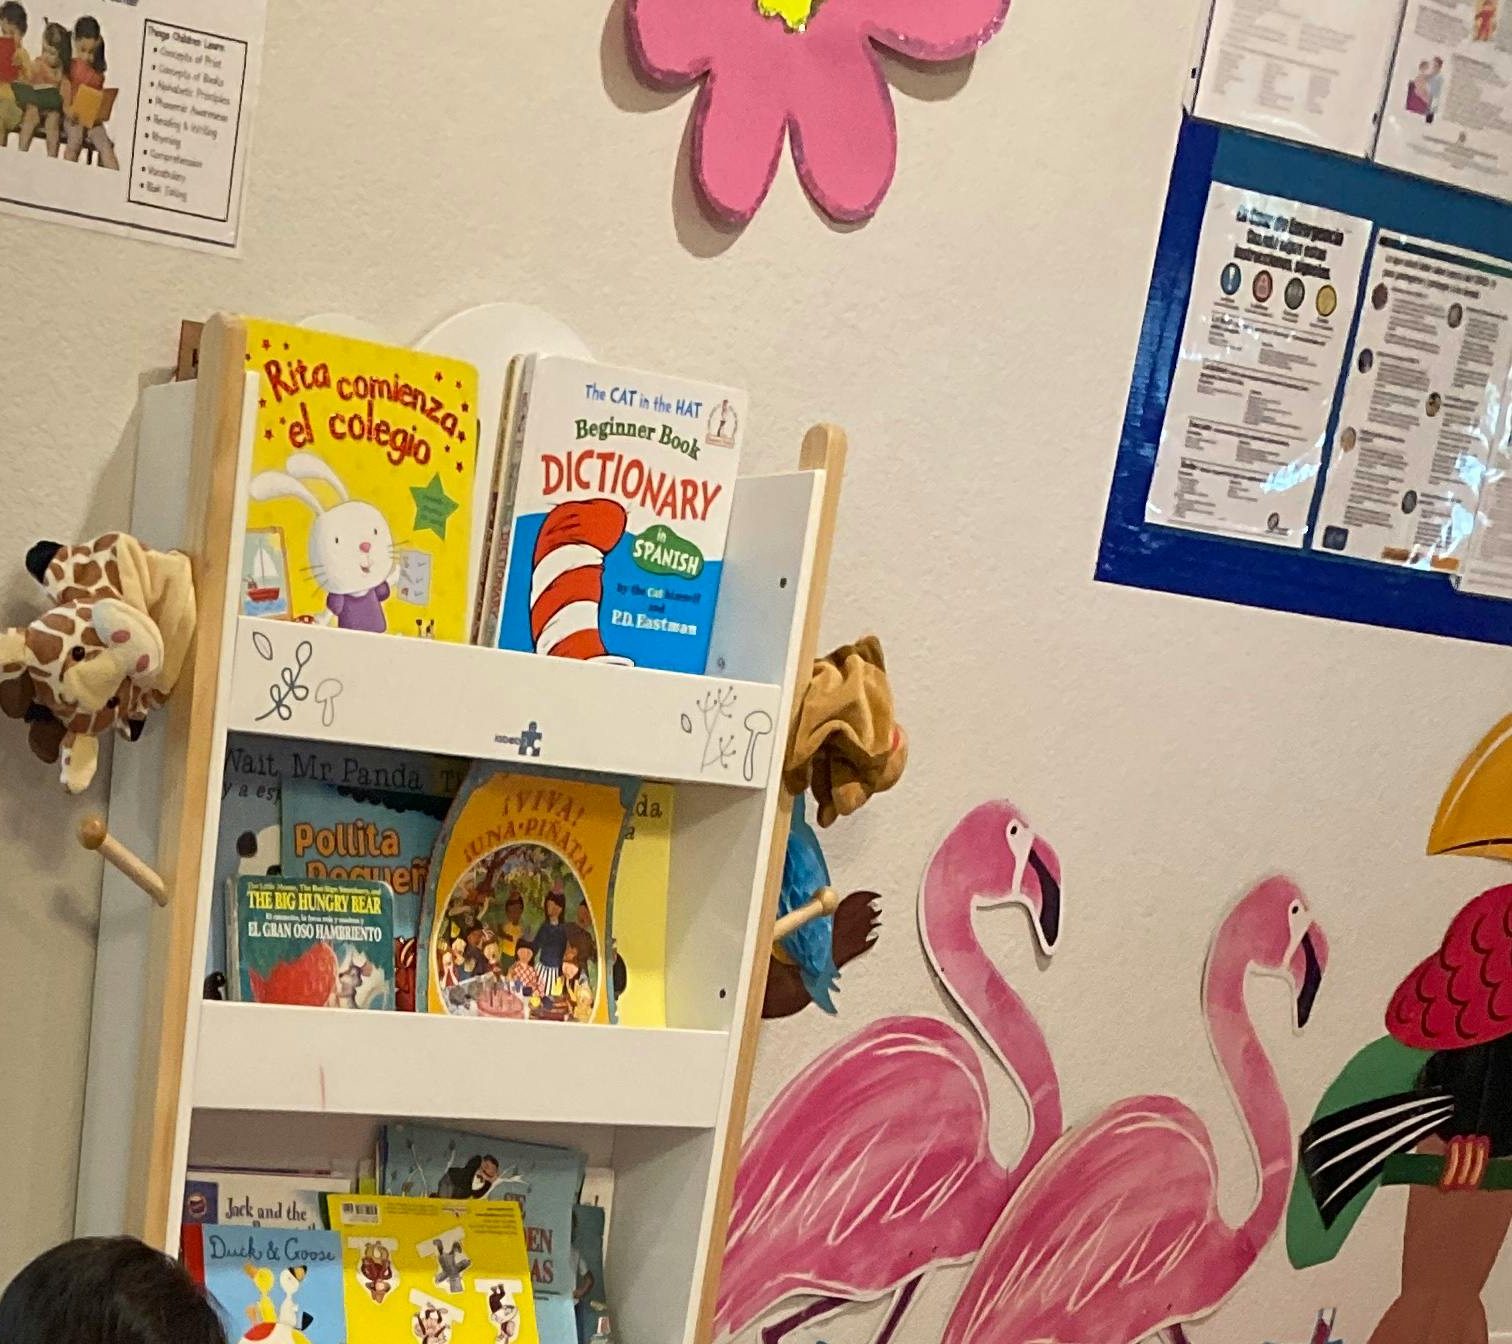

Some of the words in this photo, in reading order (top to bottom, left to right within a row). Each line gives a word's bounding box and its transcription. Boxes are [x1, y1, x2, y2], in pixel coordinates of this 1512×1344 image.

[264, 359, 331, 403] Rita
[337, 373, 459, 437] comienza
[585, 382, 606, 401] The
[610, 387, 637, 407] CAT
[639, 393, 649, 409] in
[654, 395, 672, 413] the
[676, 399, 702, 419] HAT
[289, 402, 314, 448] el
[329, 398, 431, 466] colegio
[575, 416, 656, 441] Beginner
[658, 424, 701, 461] Book
[541, 449, 722, 521] DICTIONARY
[656, 527, 667, 543] in
[632, 539, 700, 576] SPANISH
[635, 613, 697, 636] Eastman
[343, 757, 424, 790] Panda
[294, 818, 401, 858] Pollita
[247, 890, 273, 910] THE
[274, 892, 296, 911] BIG
[299, 893, 351, 914] HUNGRY
[351, 896, 381, 915] BEAR
[248, 921, 261, 937] EL
[262, 921, 294, 940] GRAN
[293, 923, 315, 939] OSO
[316, 925, 381, 943] HAMBRIENTO
[226, 1196, 254, 1219] Jack
[257, 1202, 282, 1219] and
[287, 1200, 307, 1222] the
[209, 1234, 263, 1261] Duck
[266, 1240, 280, 1261] &
[284, 1236, 336, 1262] Goose
